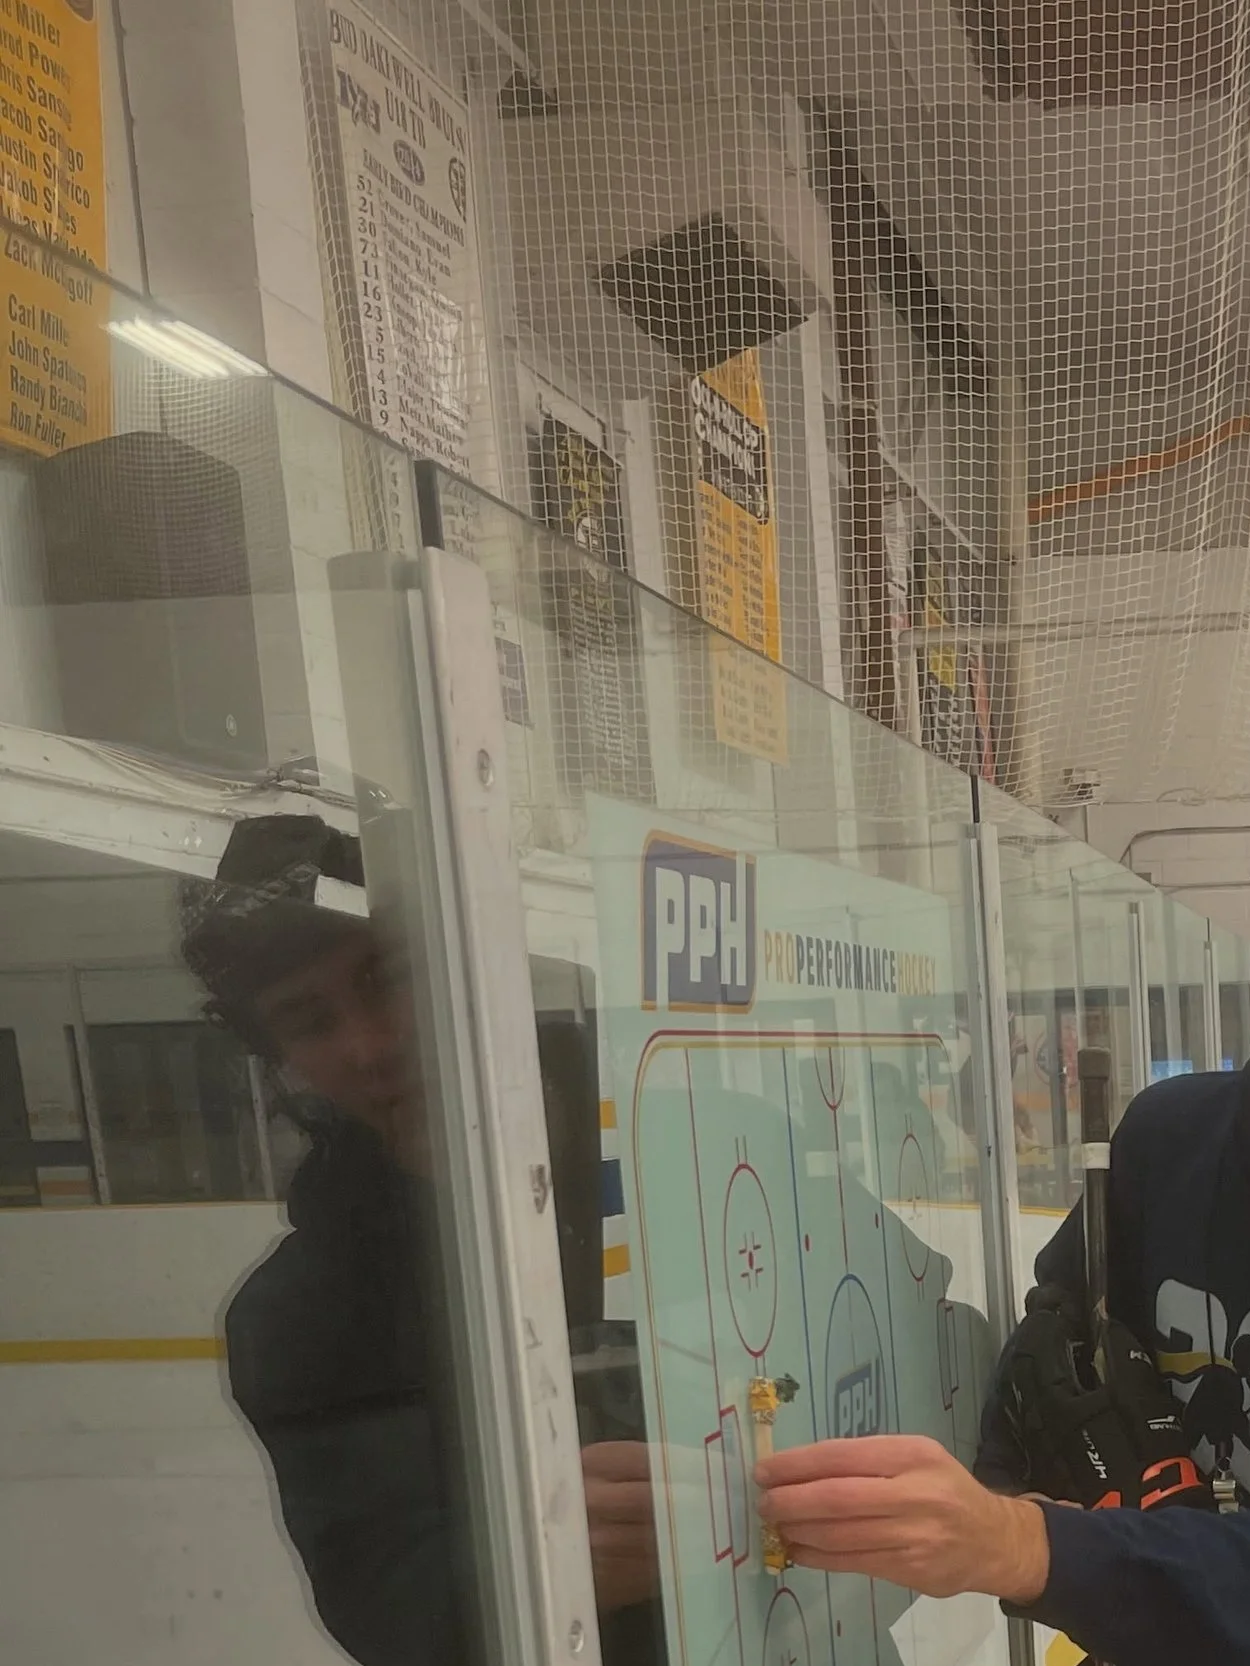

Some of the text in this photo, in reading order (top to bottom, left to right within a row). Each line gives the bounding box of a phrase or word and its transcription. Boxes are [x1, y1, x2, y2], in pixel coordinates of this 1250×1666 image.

[17, 7, 61, 48] Miller
[0, 97, 32, 135] acob
[358, 196, 375, 218] 21
[8, 294, 36, 331] Carl
[9, 330, 39, 367] John
[10, 364, 46, 411] Randy
[10, 400, 67, 450] Ron Fuller
[655, 849, 747, 1010] PPH
[838, 1353, 878, 1438] PPH
